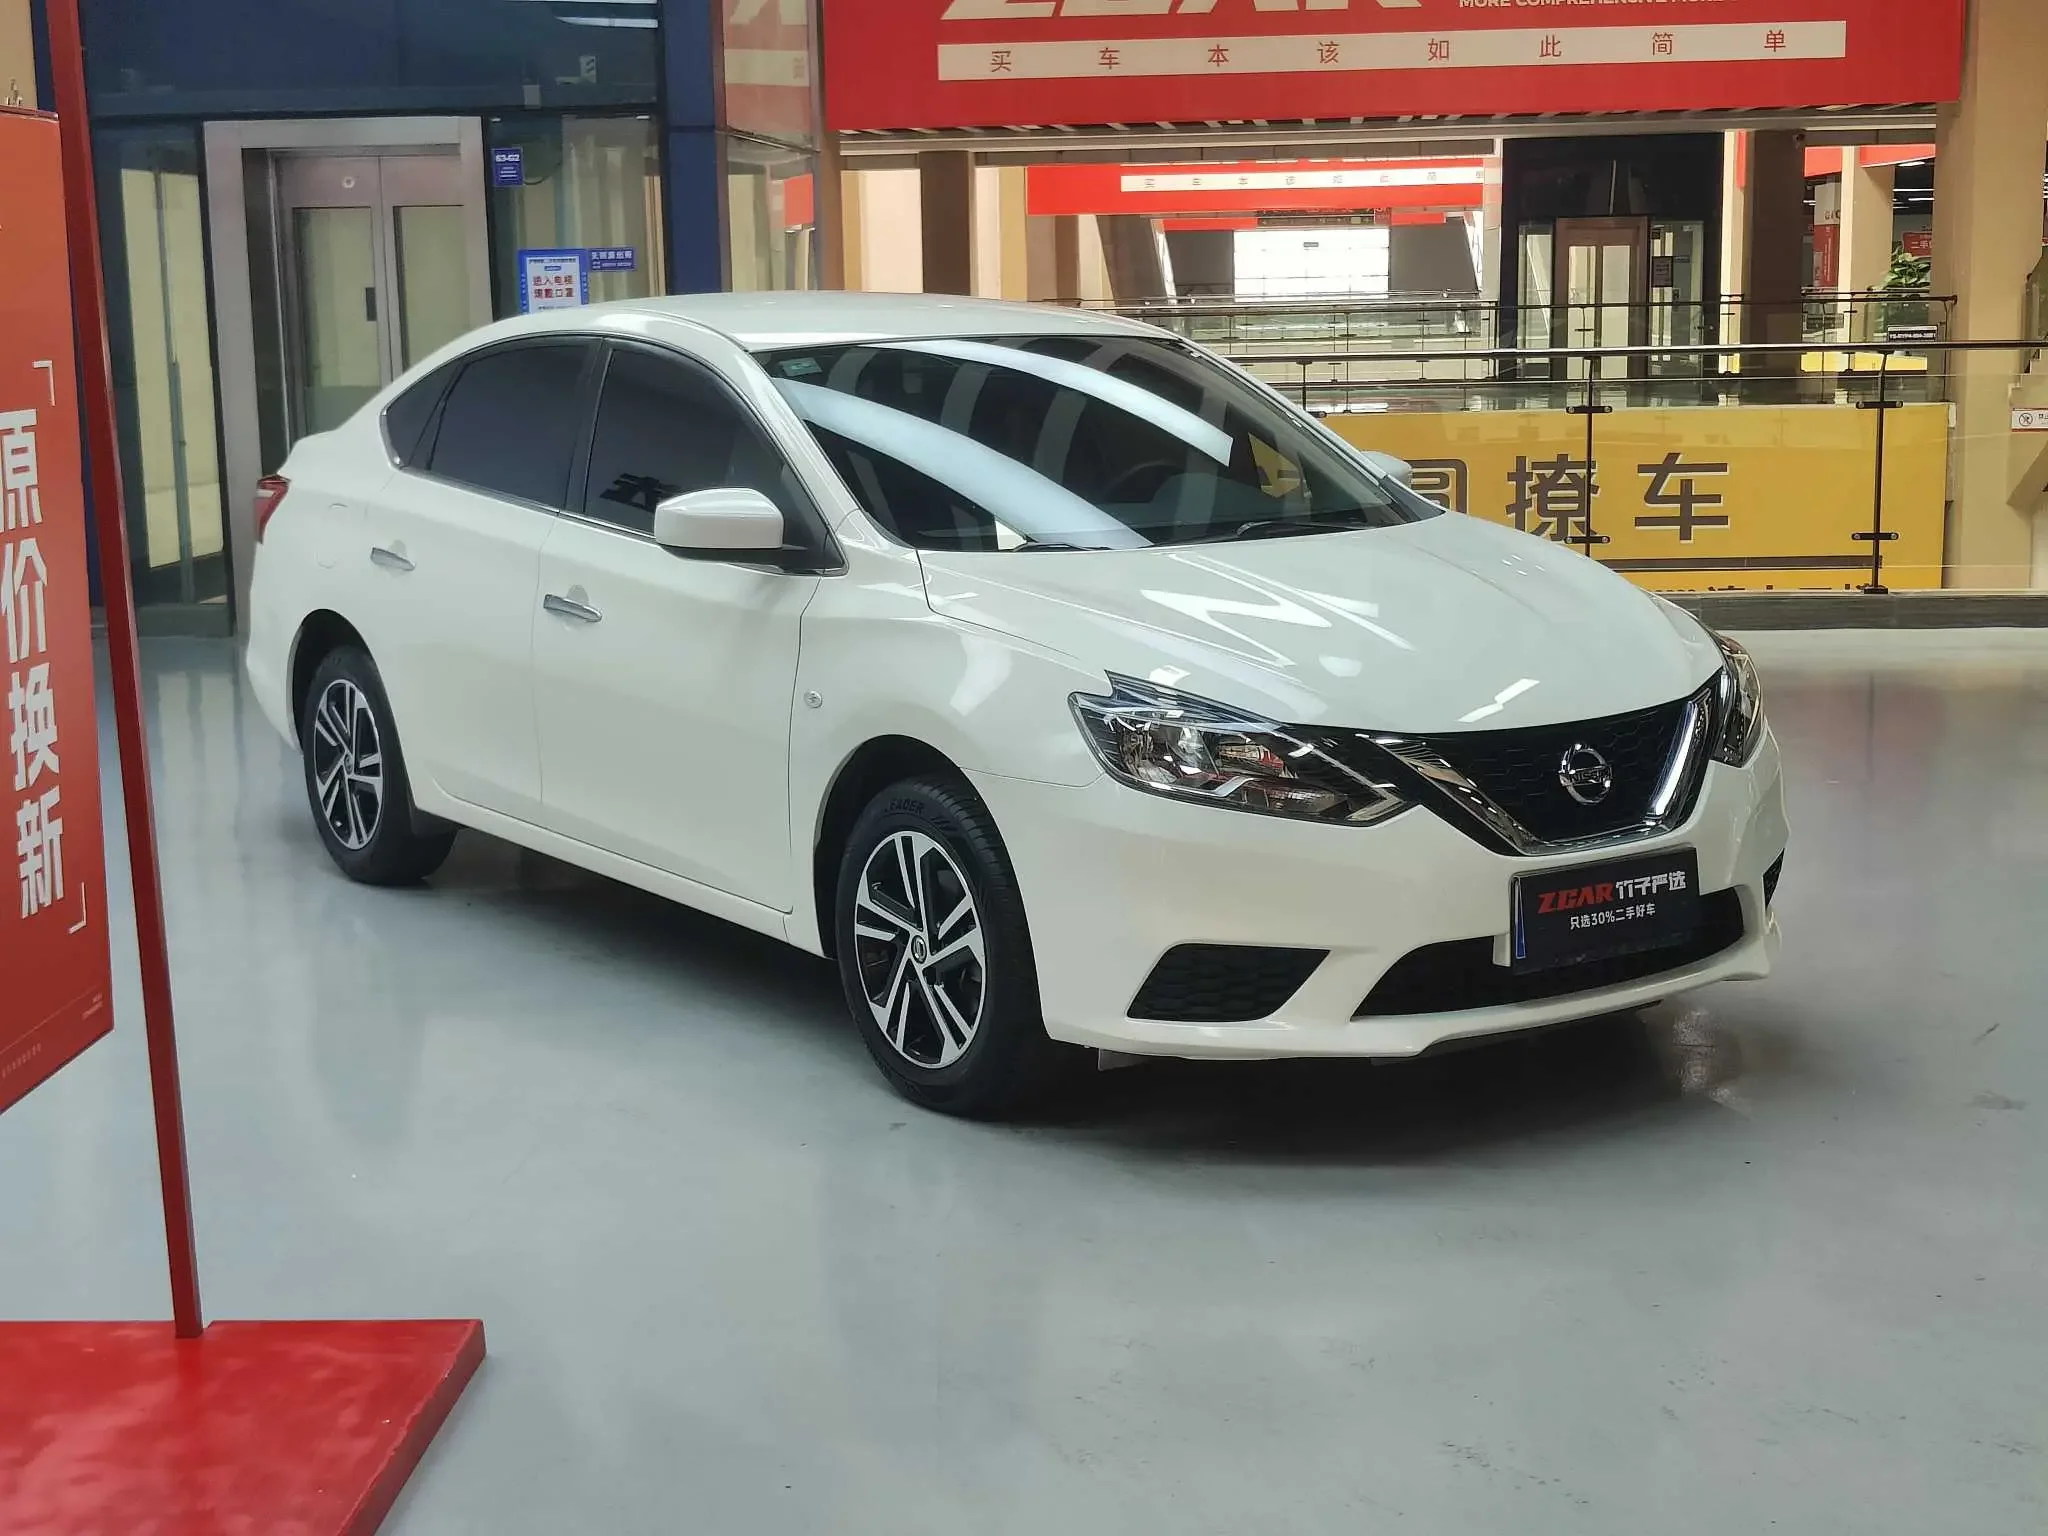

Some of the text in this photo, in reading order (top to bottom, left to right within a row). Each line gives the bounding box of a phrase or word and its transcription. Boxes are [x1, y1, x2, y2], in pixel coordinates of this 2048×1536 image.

[990, 29, 1787, 73] 买车本该如此简单
[0, 408, 64, 919] 原价换新
[1615, 870, 1686, 900] 竹子严选
[1570, 903, 1656, 930] 只选30%二手好车
